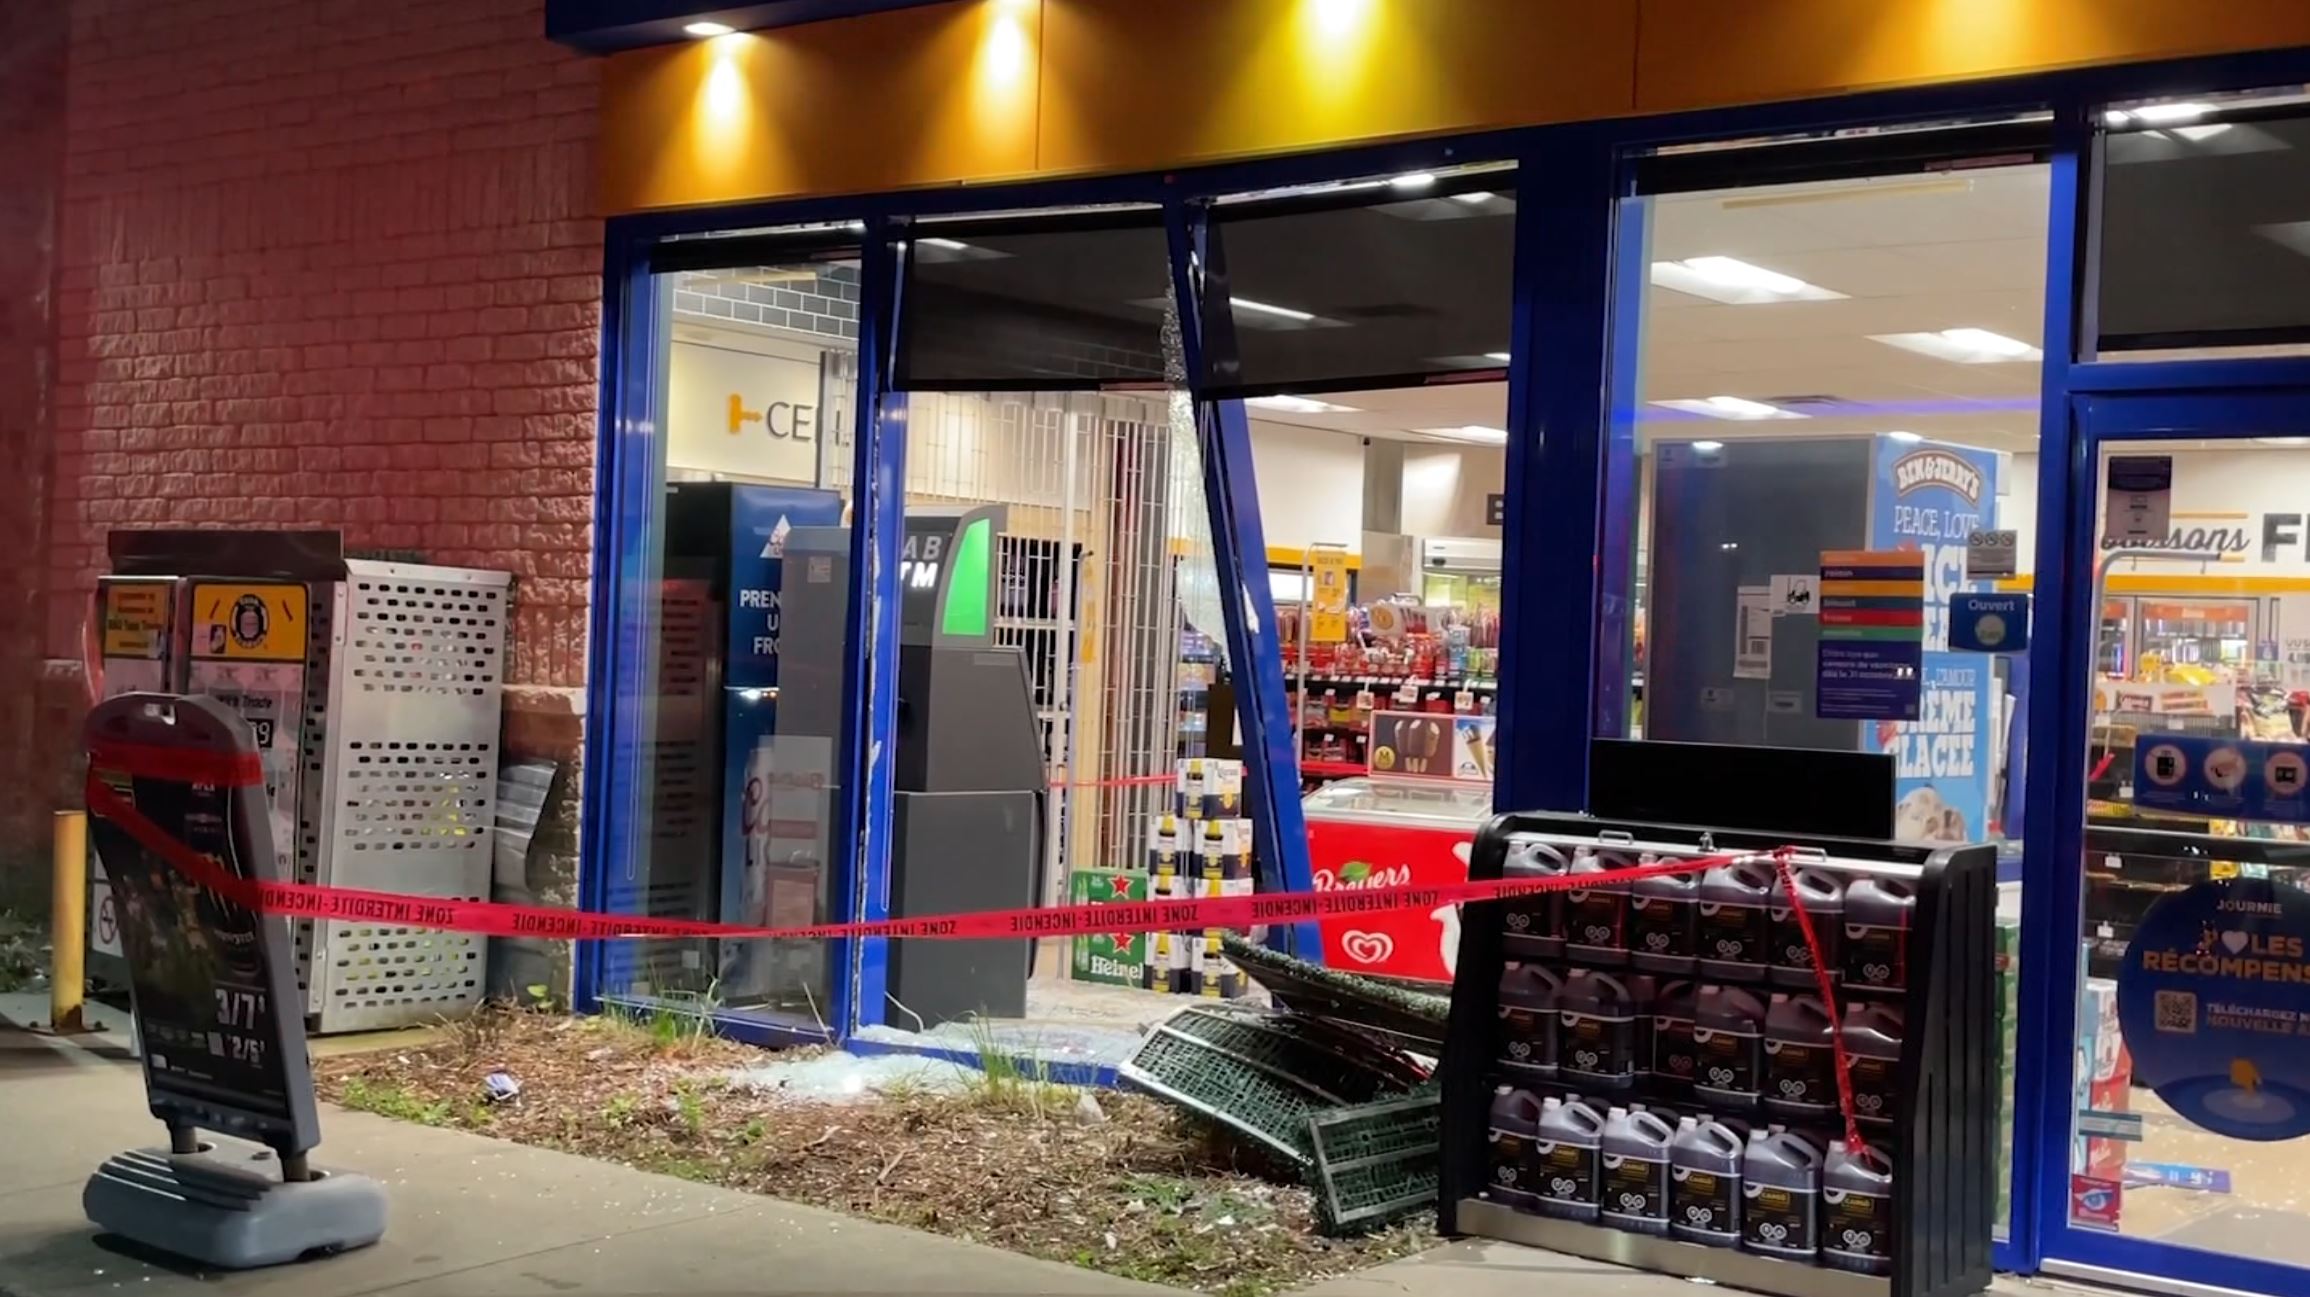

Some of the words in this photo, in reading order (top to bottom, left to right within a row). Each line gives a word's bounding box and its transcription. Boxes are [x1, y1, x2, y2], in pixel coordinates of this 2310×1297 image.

[1893, 505, 1941, 541] PEACE,
[1968, 599, 2015, 612] Ouvert
[1163, 903, 1198, 922] ZONE
[2216, 899, 2282, 914] JOURNIE
[920, 920, 957, 936] ZONE
[2251, 933, 2304, 958] LES
